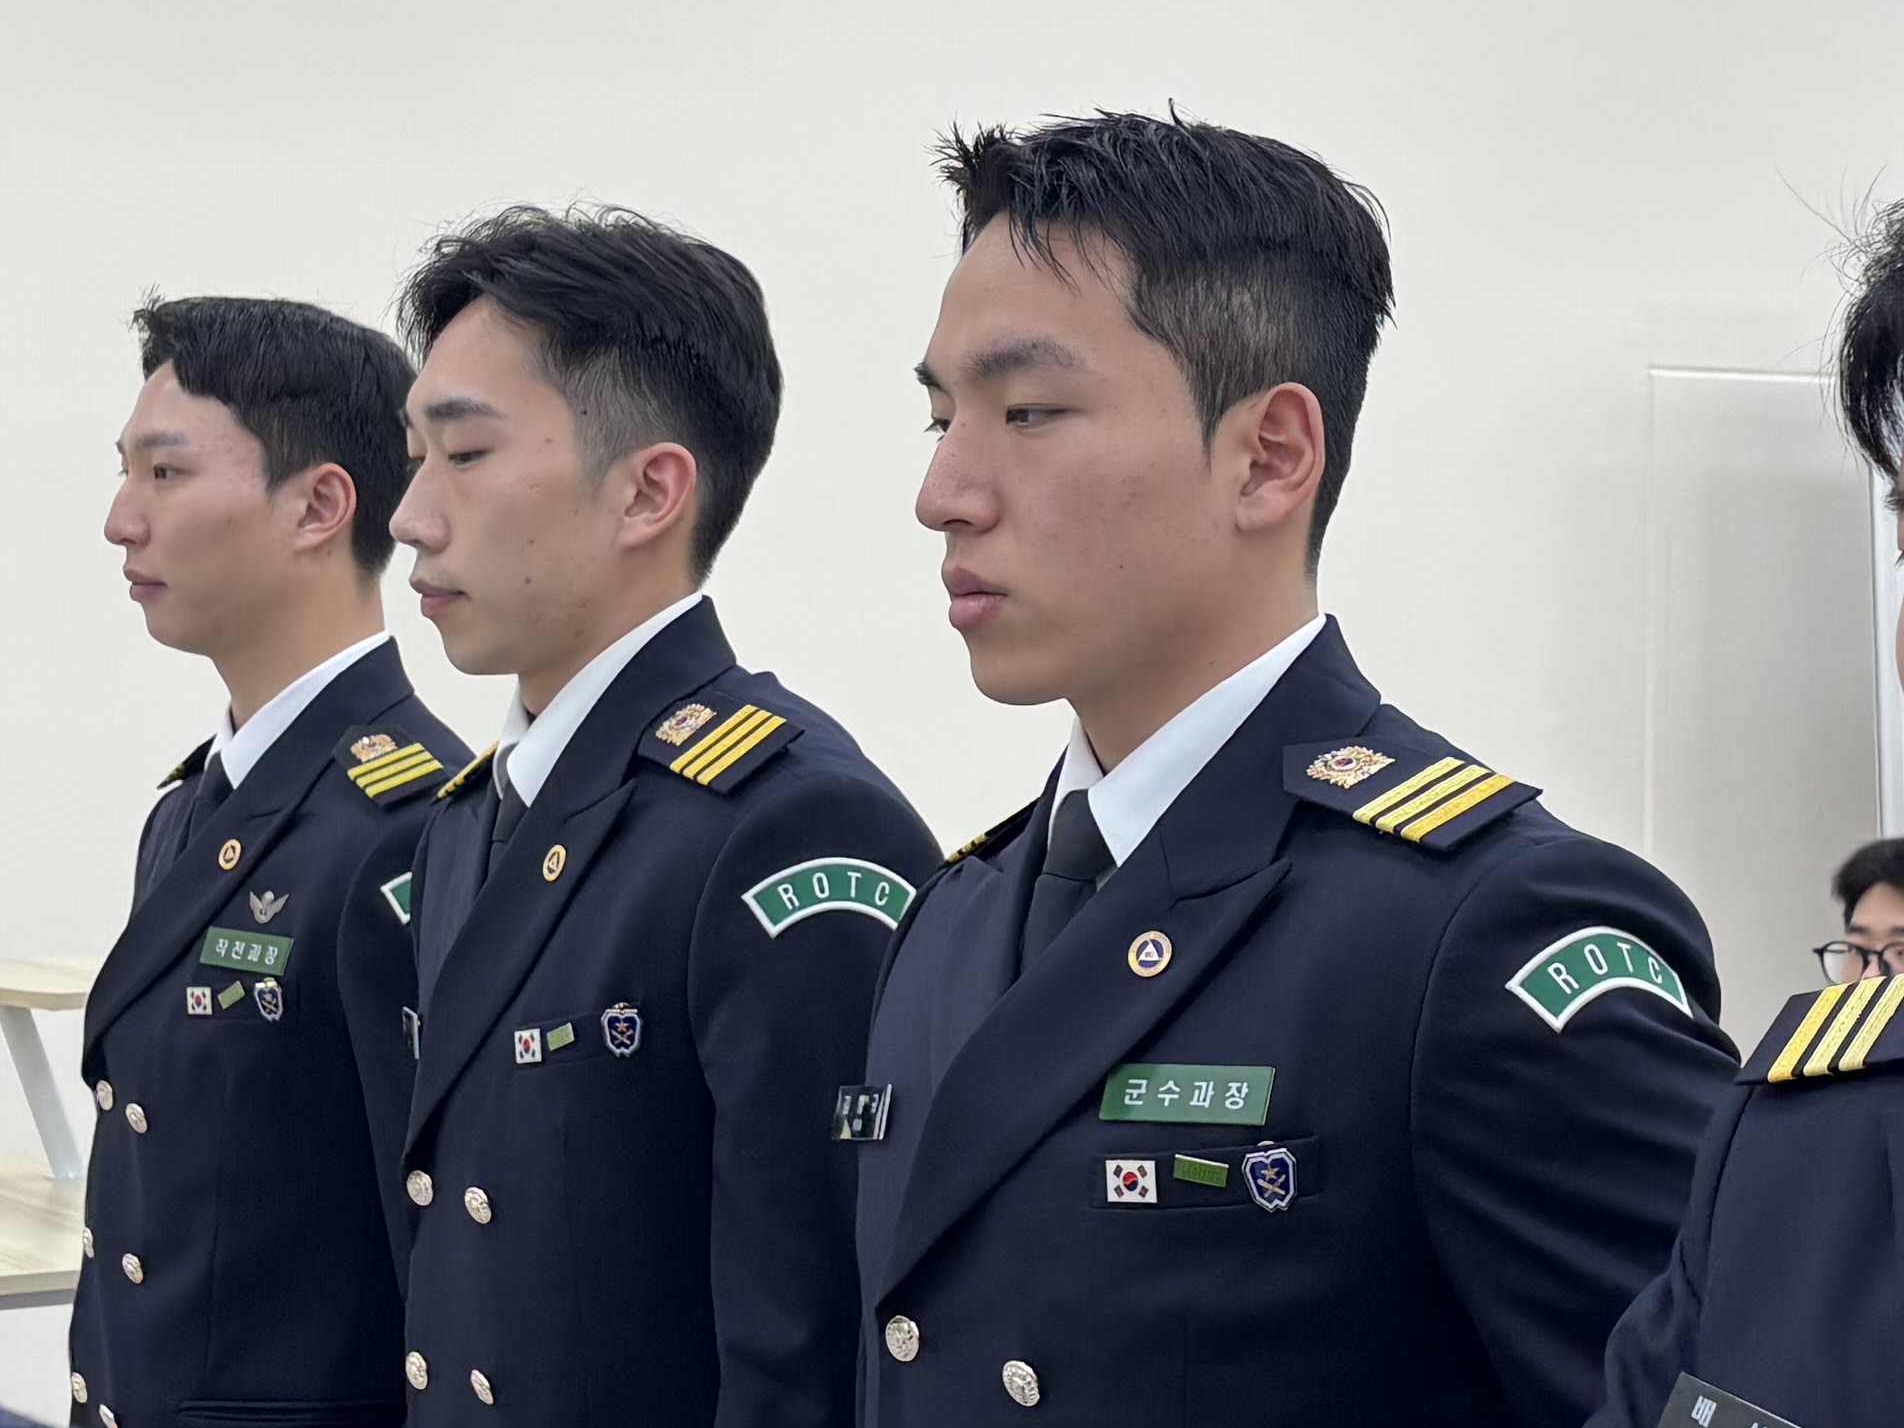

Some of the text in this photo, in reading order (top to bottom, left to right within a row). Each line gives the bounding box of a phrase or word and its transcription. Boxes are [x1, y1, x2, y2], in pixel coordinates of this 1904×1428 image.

[777, 871, 890, 910] ROTC
[1548, 943, 1663, 995] ROTC
[1124, 1079, 1249, 1110] 군수과장
